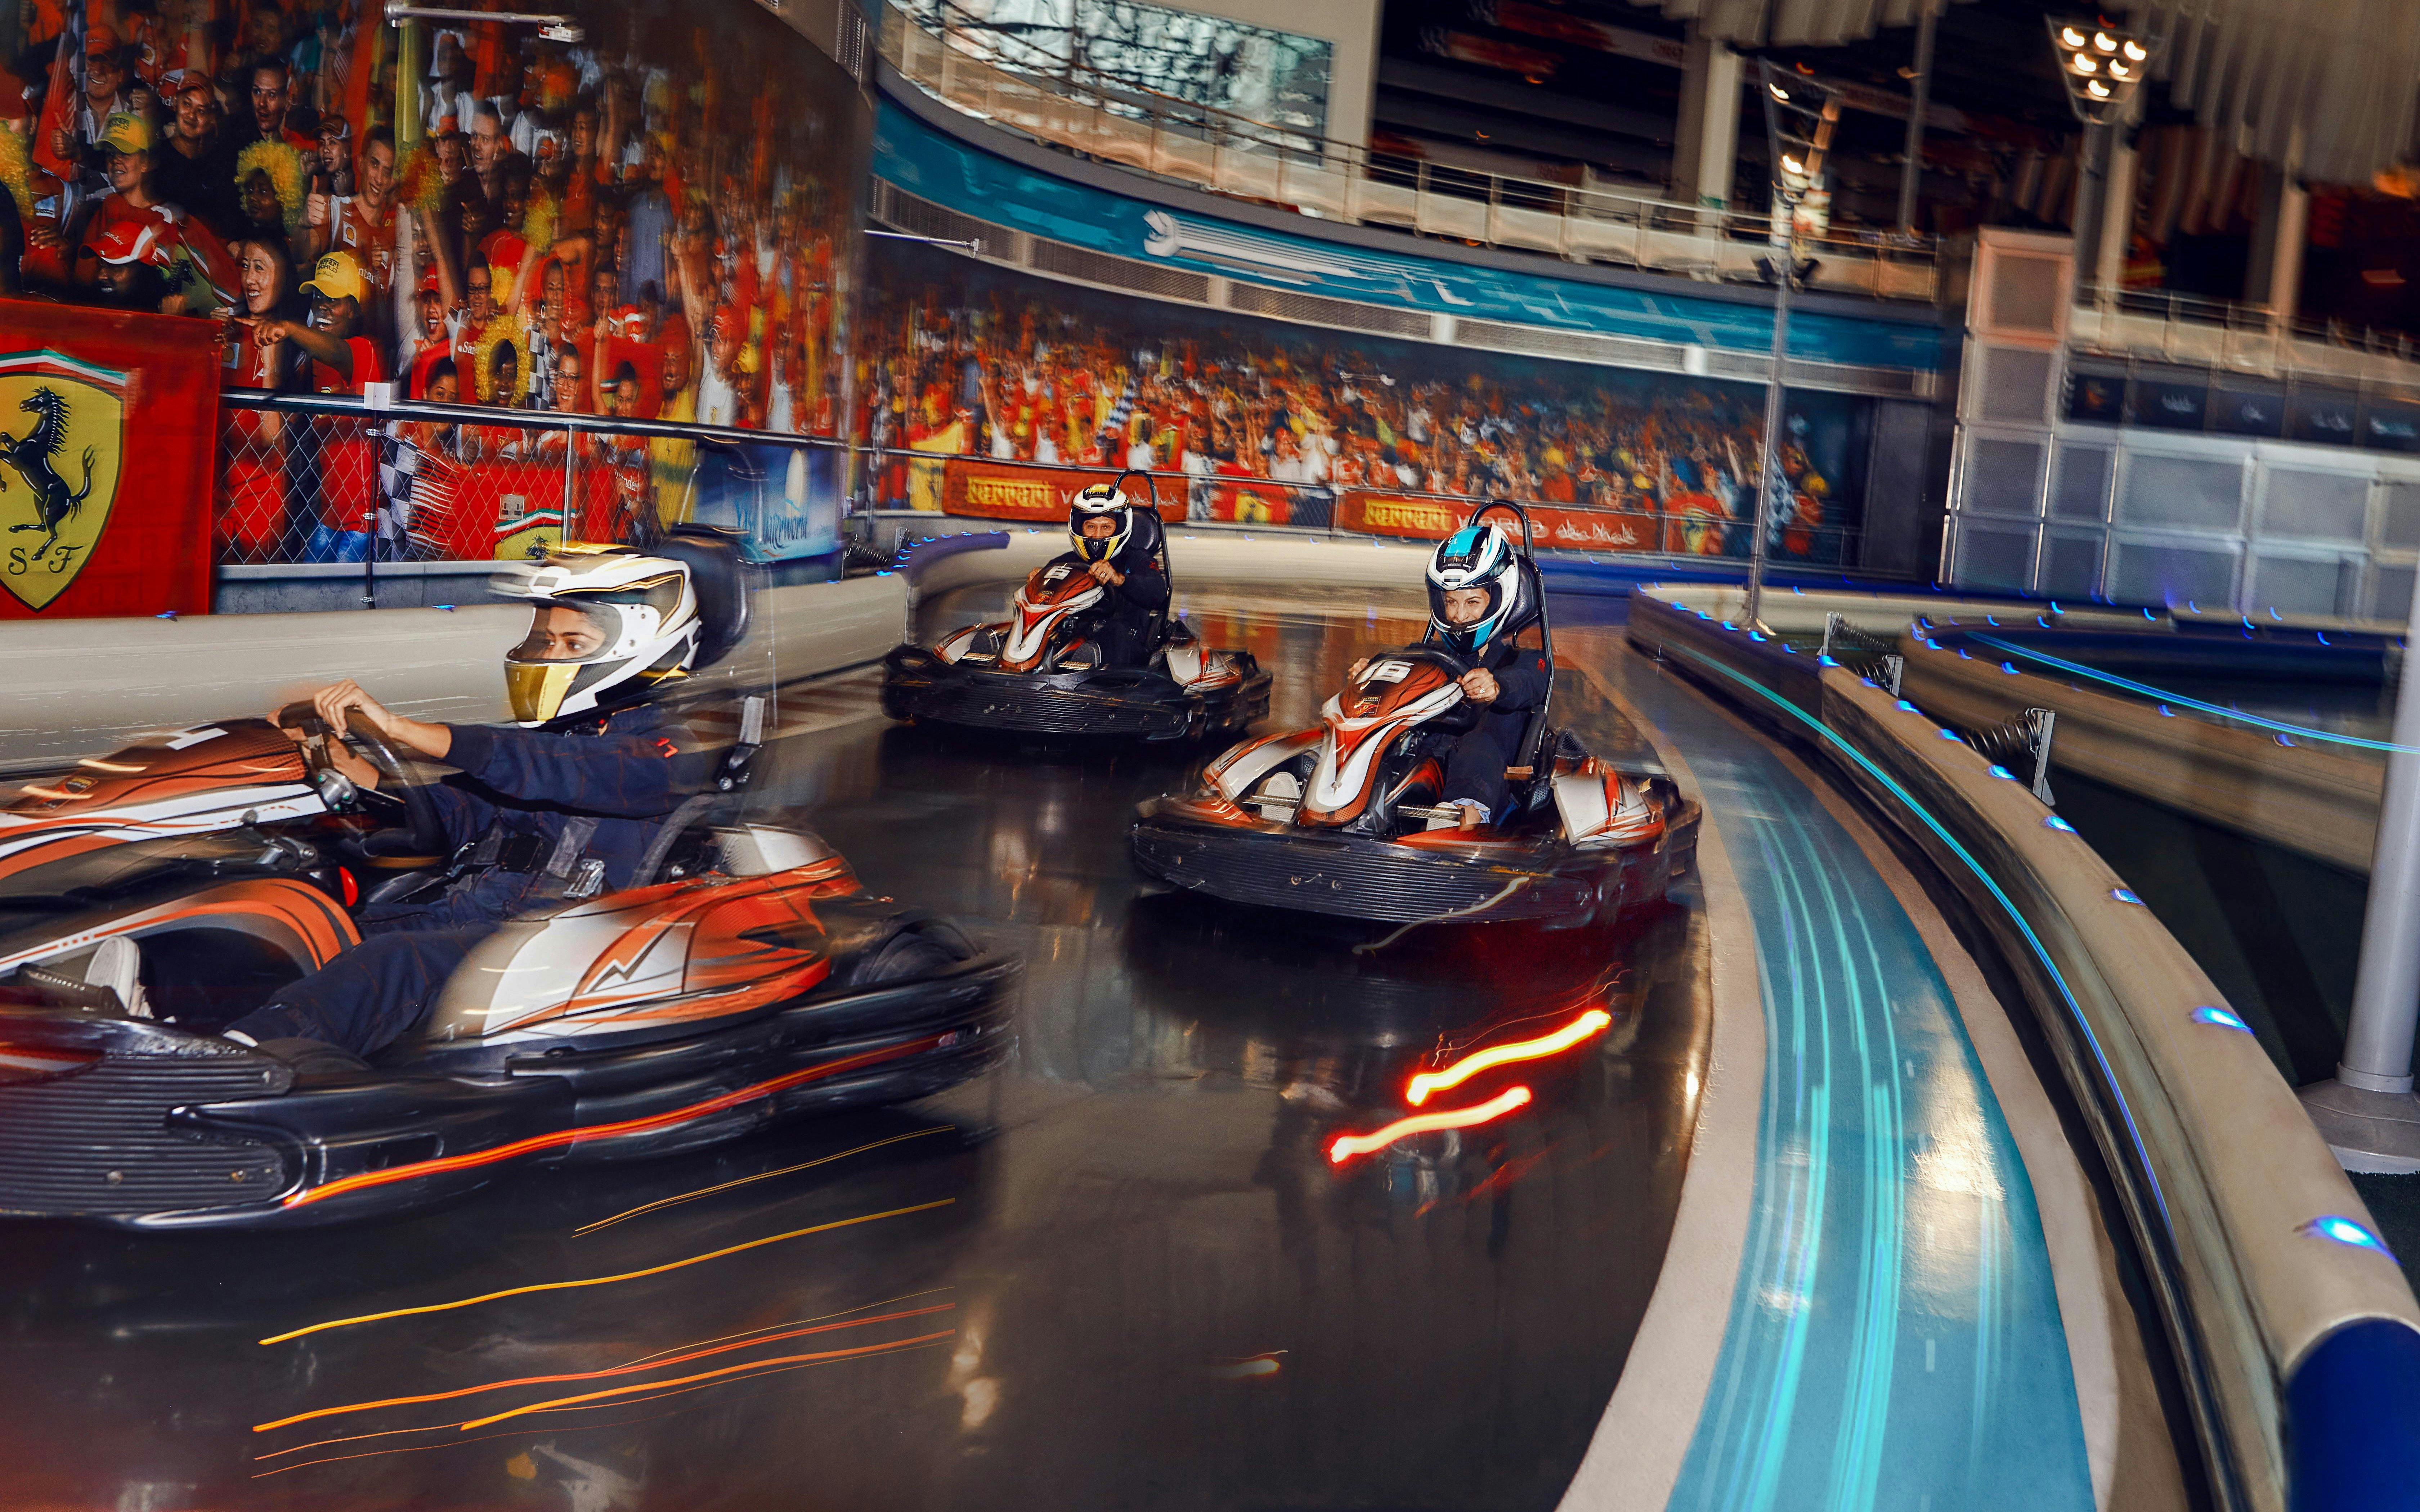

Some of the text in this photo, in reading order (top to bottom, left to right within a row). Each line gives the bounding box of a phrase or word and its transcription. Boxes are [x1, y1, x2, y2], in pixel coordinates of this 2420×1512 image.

[965, 476, 1056, 508] Ferrari
[1362, 499, 1453, 532] Ferrari
[8, 545, 84, 576] S F
[1354, 660, 1415, 683] 16
